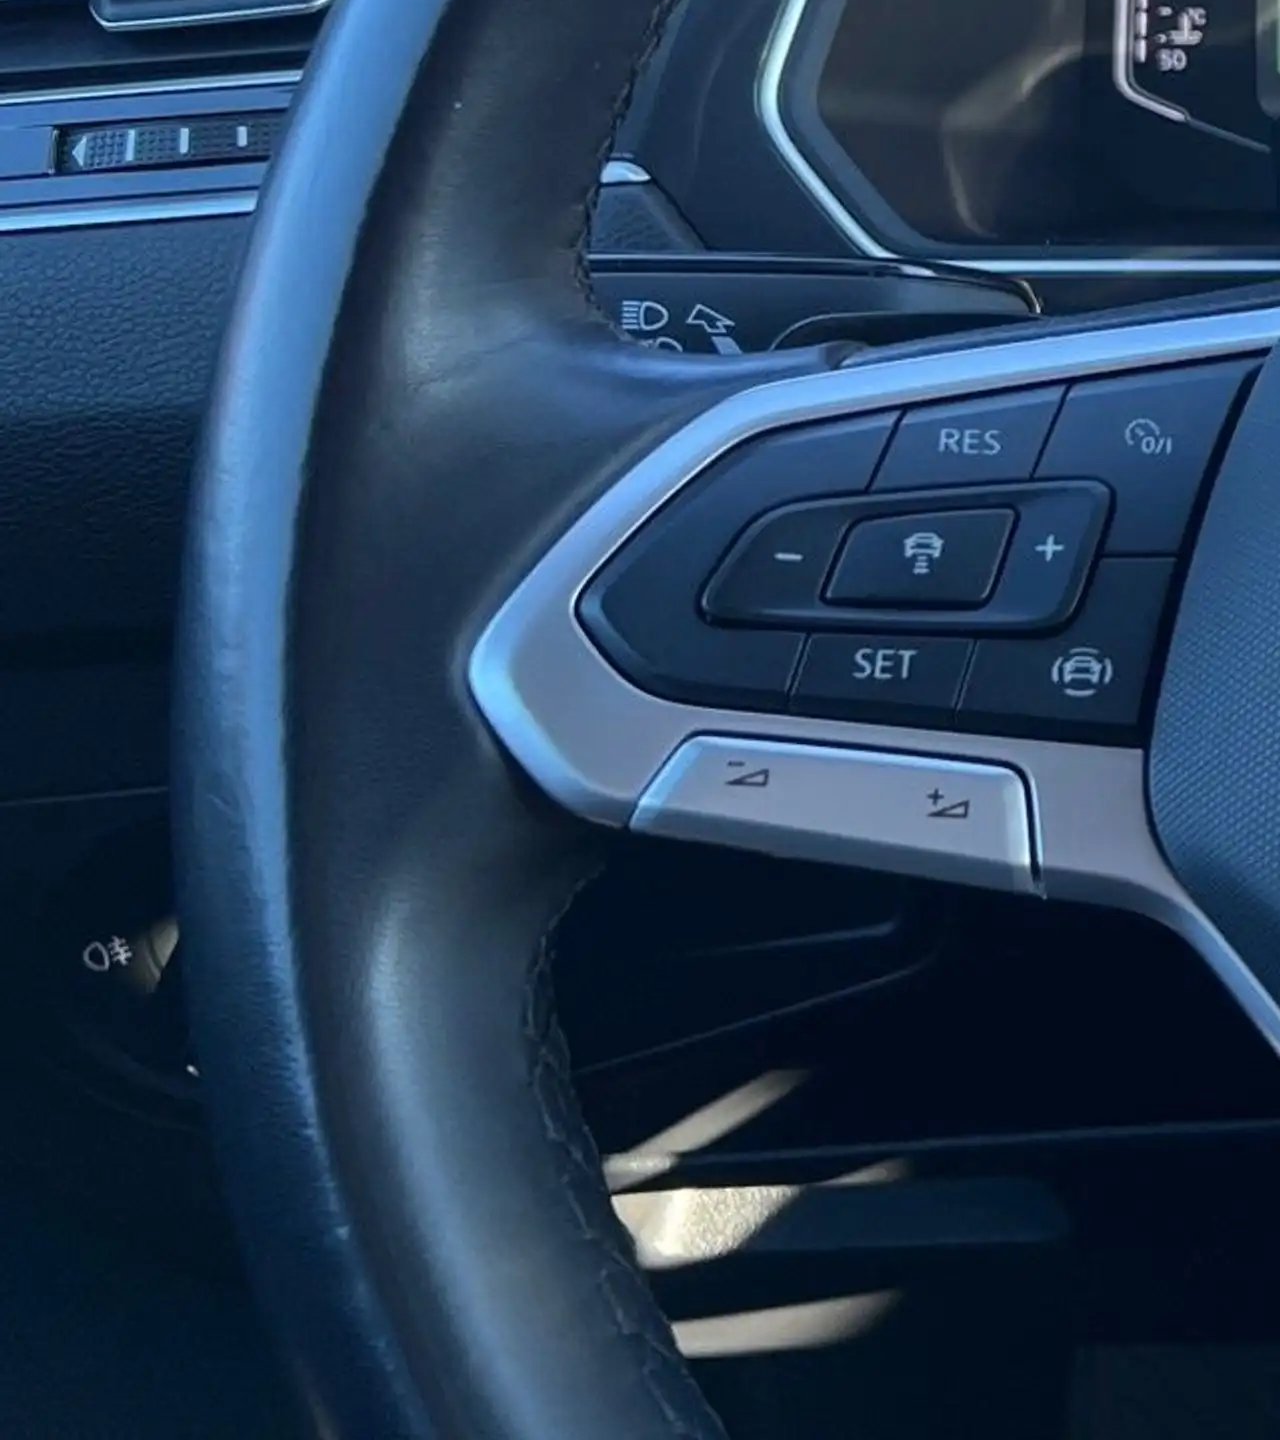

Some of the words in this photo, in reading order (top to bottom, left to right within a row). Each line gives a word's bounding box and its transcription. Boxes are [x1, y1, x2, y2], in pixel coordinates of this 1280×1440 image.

[1155, 48, 1188, 72] 50
[938, 428, 1002, 456] RES
[853, 647, 918, 681] SET
